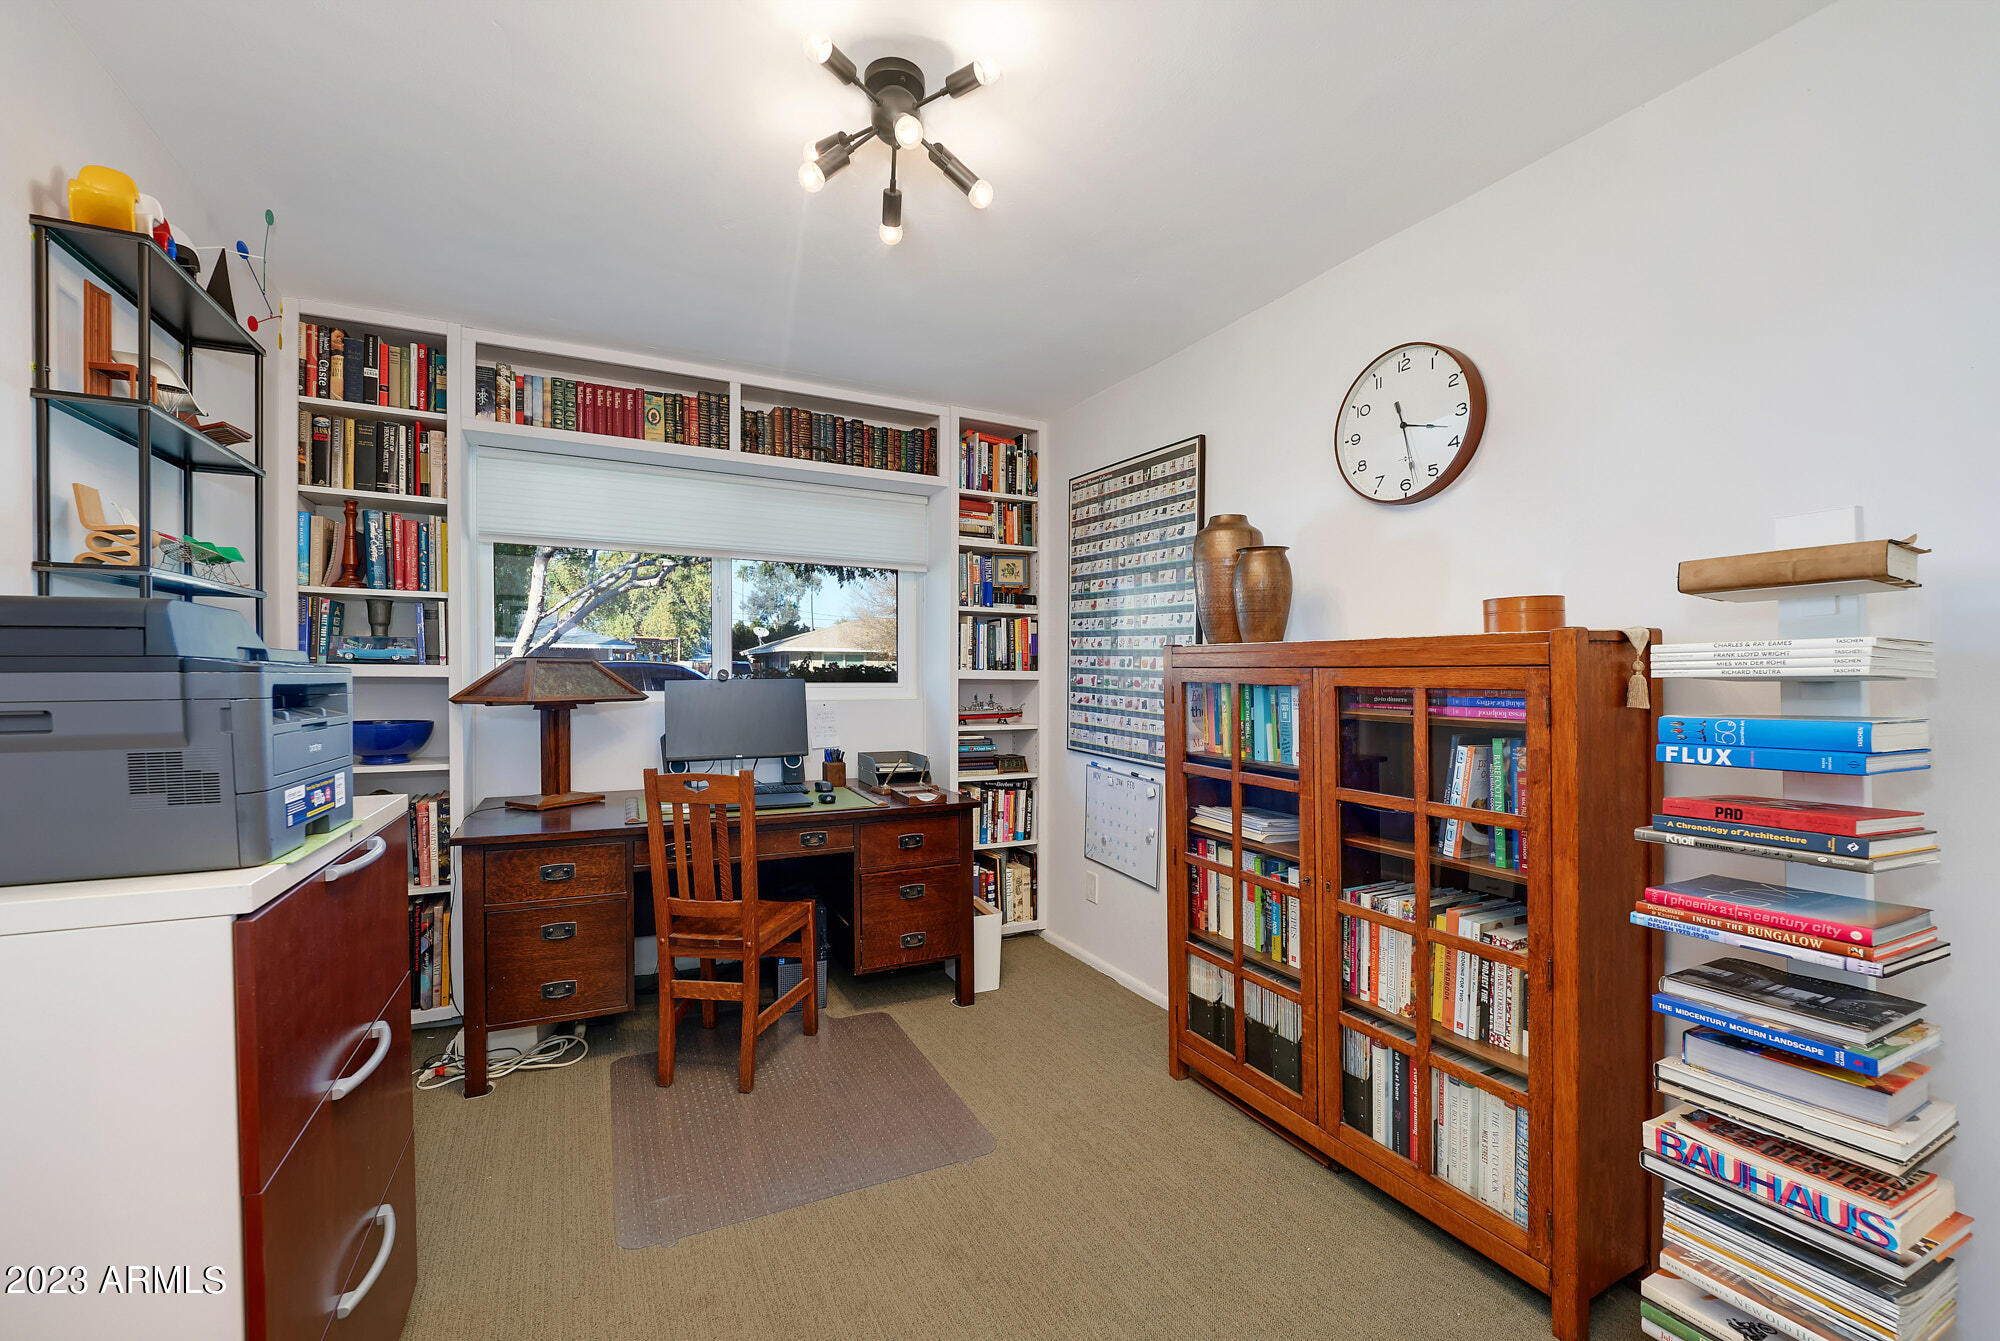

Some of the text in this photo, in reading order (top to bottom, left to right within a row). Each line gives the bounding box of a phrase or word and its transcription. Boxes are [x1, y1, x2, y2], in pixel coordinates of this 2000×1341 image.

[1398, 358, 1411, 373] 12
[319, 360, 329, 386] Caste
[1448, 373, 1459, 387] 2
[1376, 376, 1382, 390] 11
[1356, 404, 1371, 418] 10
[1455, 402, 1468, 416] 3
[1350, 434, 1361, 446] 9
[1447, 435, 1460, 448] 4
[1357, 460, 1368, 472] 8
[1428, 464, 1439, 477] 5
[1375, 475, 1385, 490] 7
[1400, 478, 1412, 492] 6
[1666, 746, 1732, 766] FLUX
[1494, 754, 1502, 813] BAREFOOT IN
[1715, 806, 1743, 820] PAD
[1665, 833, 1696, 846] Knoll
[1676, 822, 1728, 835] Chronology
[1743, 830, 1807, 844] Architecture
[1671, 896, 1718, 912] phoenix
[1753, 913, 1808, 930] century
[1812, 924, 1841, 937] city
[1648, 917, 1700, 932] ARCHITECTURE
[1648, 922, 1674, 931] DESIGN
[1692, 916, 1823, 949] INSIDE THE BUNGALOW
[1657, 1002, 1824, 1056] THE MIDCENTURY MODERN LANDSCAPE
[1395, 1052, 1400, 1060] ad
[1492, 1154, 1499, 1167] TO
[1656, 1127, 1898, 1252] BAUHAUS
[1735, 1297, 1761, 1317] NEW
[1765, 1312, 1792, 1332] OLD
